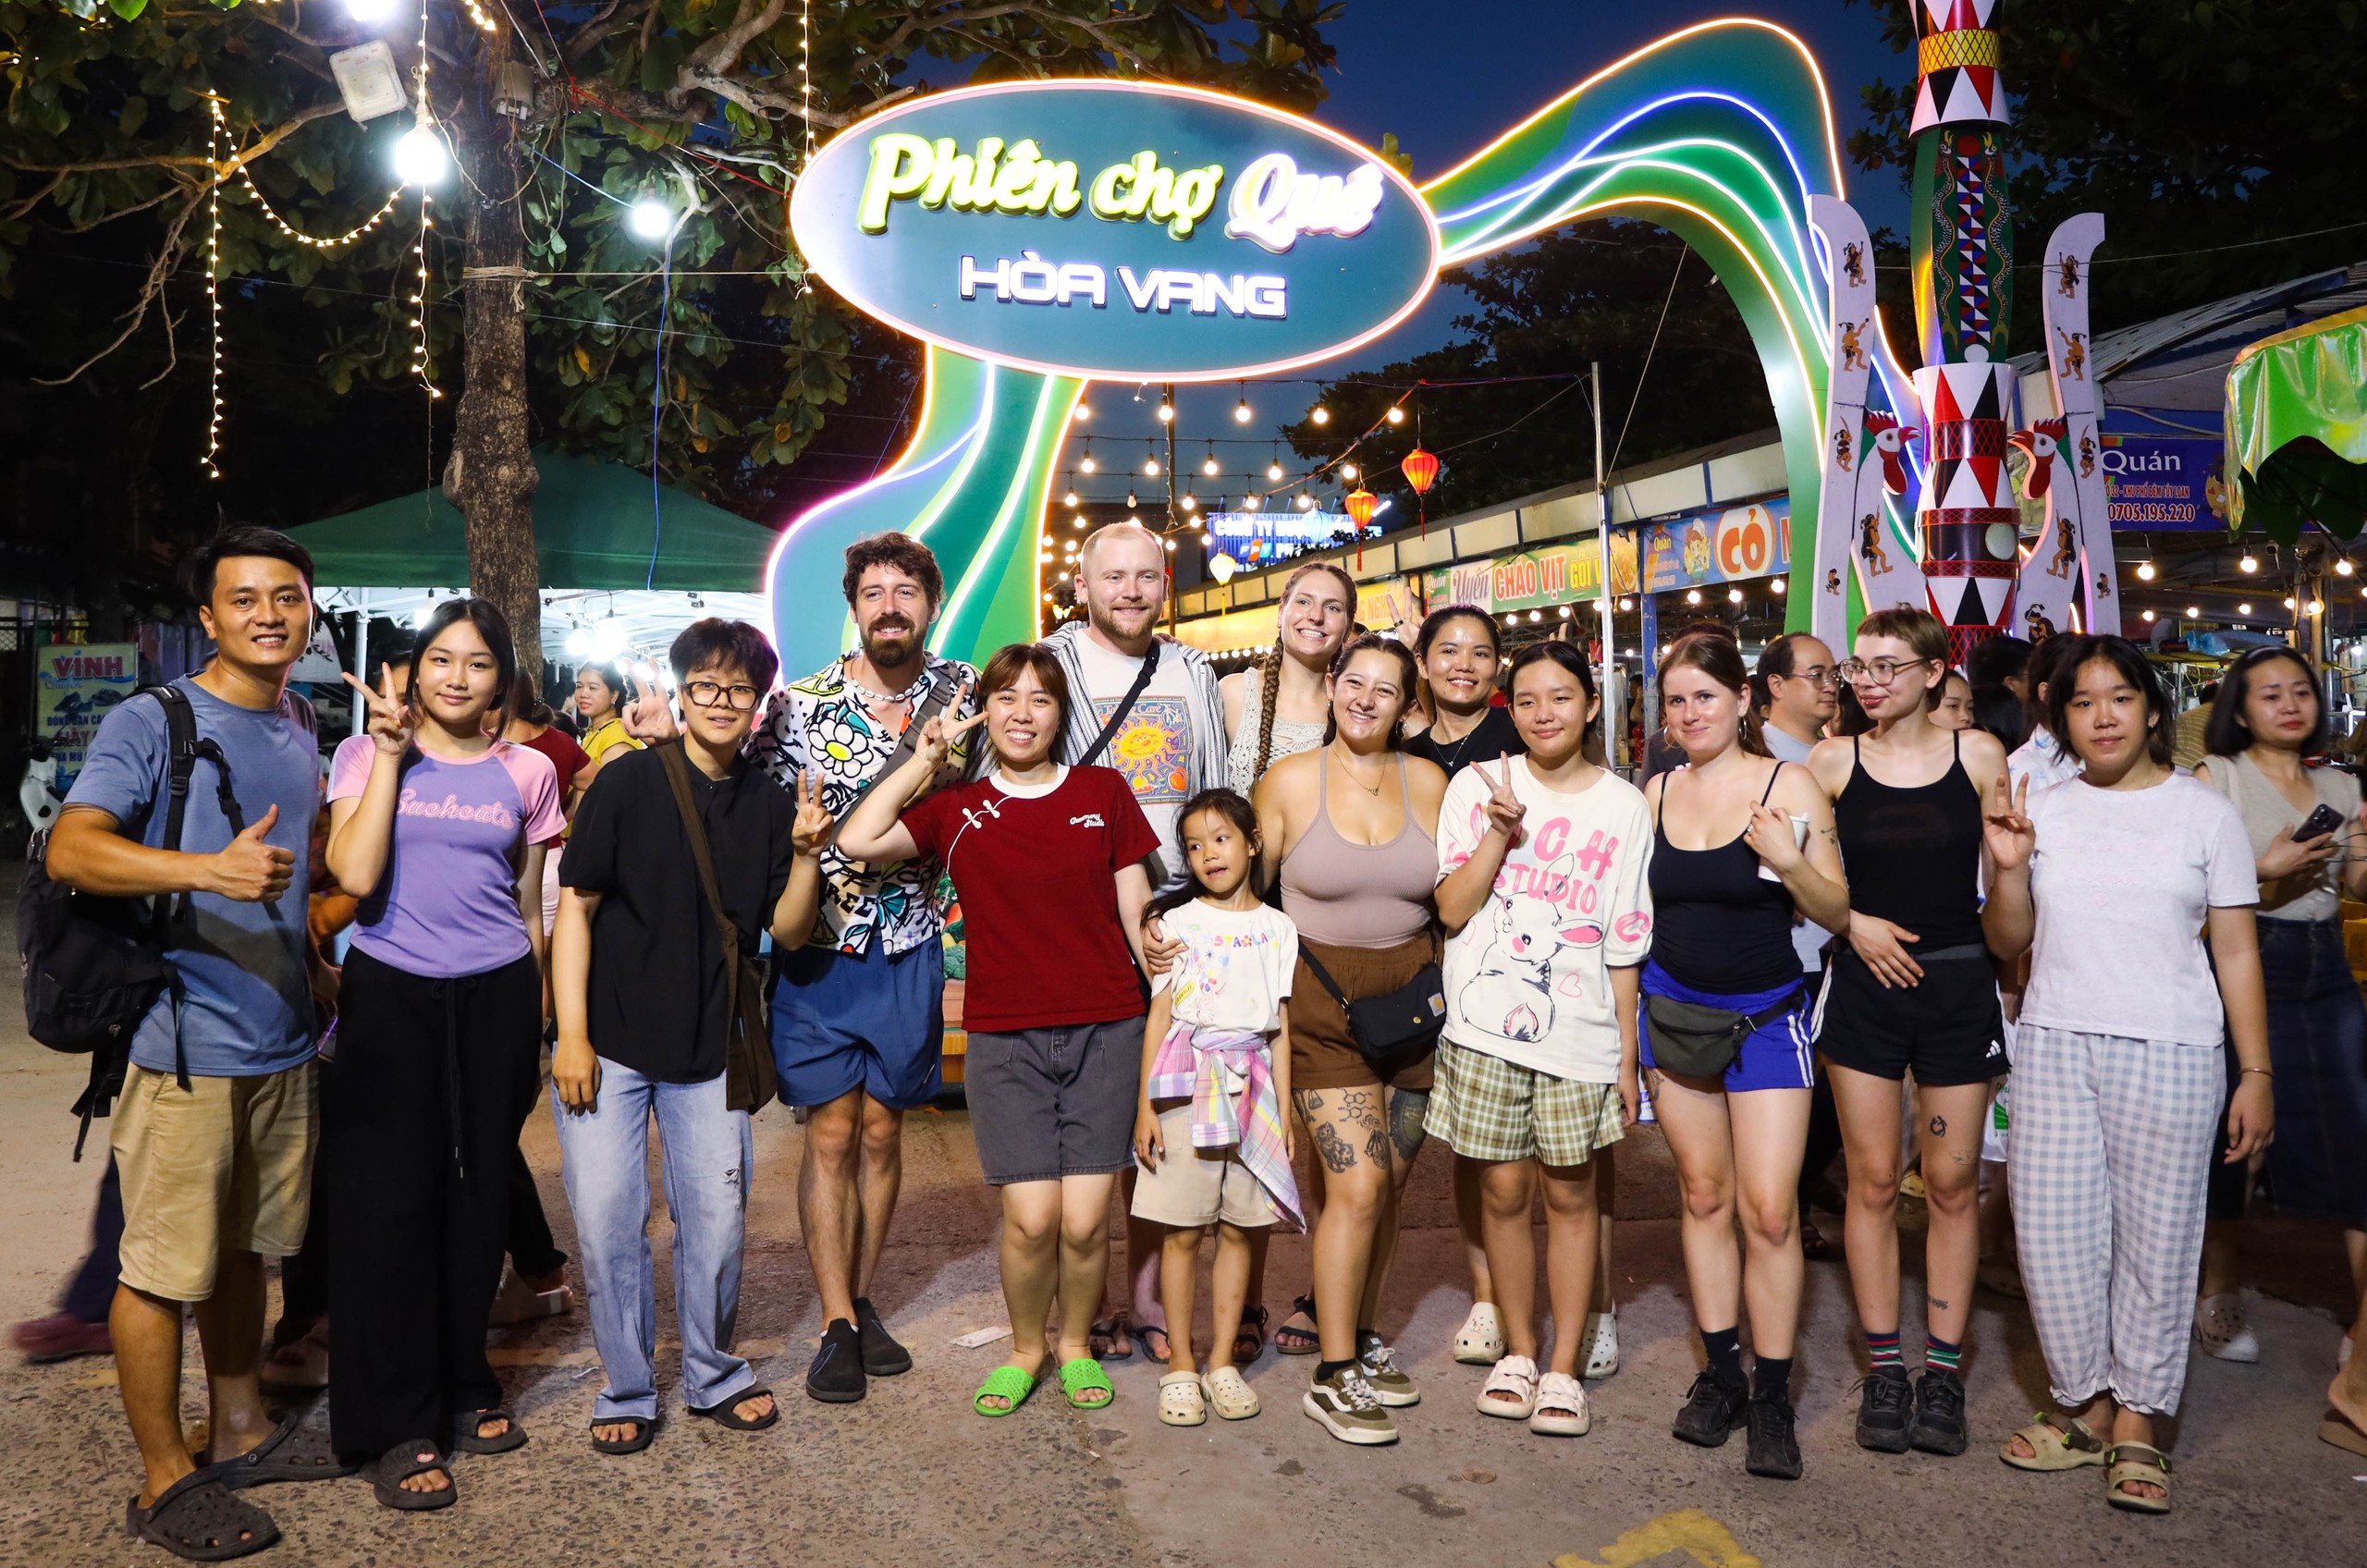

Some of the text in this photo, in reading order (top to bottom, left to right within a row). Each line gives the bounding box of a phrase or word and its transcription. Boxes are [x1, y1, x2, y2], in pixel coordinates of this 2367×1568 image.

[856, 133, 1083, 235] Phiên
[1088, 150, 1223, 241] chợ
[960, 249, 1288, 320] HÒA VANG
[2101, 450, 2181, 475] Quán
[2108, 503, 2195, 522] 0705.195.220
[1721, 508, 1766, 574] CỎ
[1494, 557, 1537, 601] CHÁO
[1539, 555, 1566, 601] VỊT
